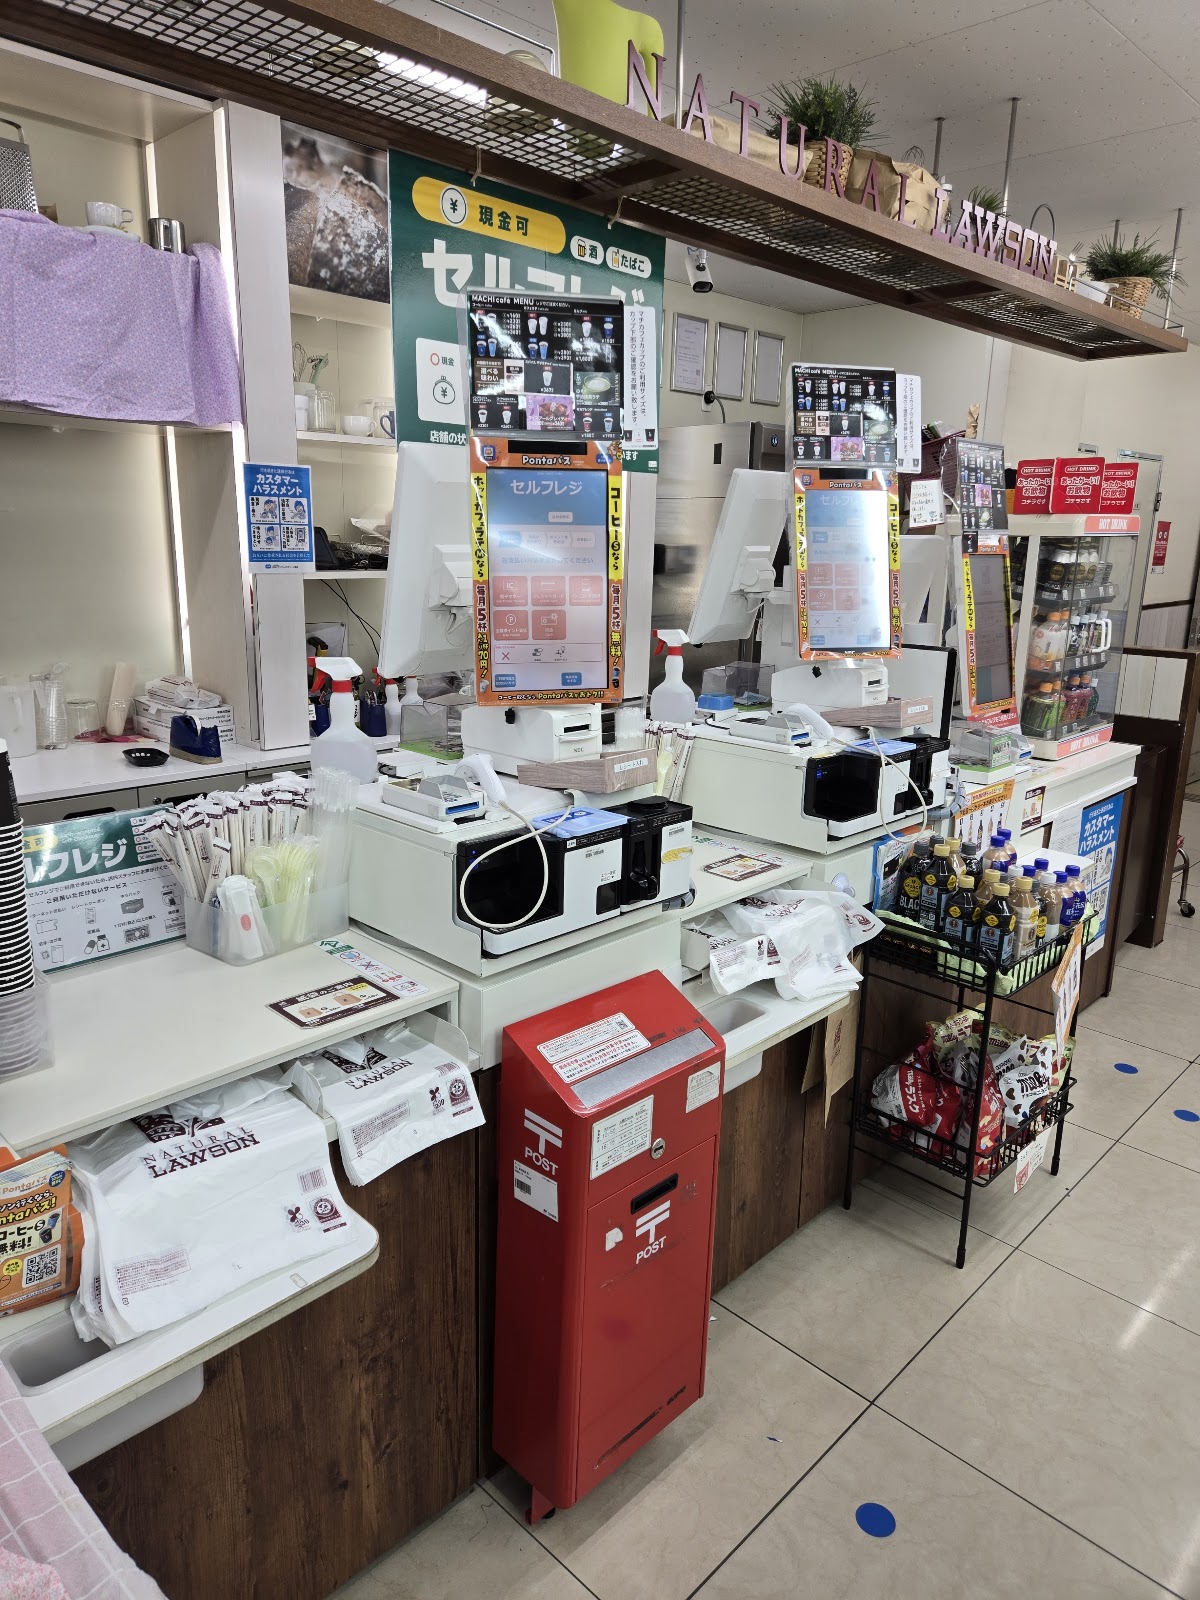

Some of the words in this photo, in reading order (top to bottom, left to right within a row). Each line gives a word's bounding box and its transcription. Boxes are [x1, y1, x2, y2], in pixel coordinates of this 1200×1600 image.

[624, 38, 918, 230] NATURAL
[931, 187, 1058, 284] LAWSON
[478, 204, 530, 237] 現金可
[588, 244, 598, 260] 酒
[620, 254, 646, 273] たばこ
[471, 295, 496, 304] MACHI
[513, 297, 535, 306] MENU
[441, 356, 455, 367] 現金
[430, 430, 467, 445] 店舗の状
[522, 455, 572, 466] Pontaパス
[256, 473, 299, 485] カスタマー
[510, 480, 583, 496] セルフレジ
[252, 484, 303, 496] ハラスメント
[1022, 487, 1047, 497] お飲物
[1066, 486, 1092, 496] お飲物
[1103, 488, 1127, 498] お飲物
[1099, 518, 1110, 530] HOT
[1110, 518, 1129, 530] DRINK
[476, 585, 488, 633] 毎月5杯
[611, 584, 622, 631] 毎月5杯
[1084, 814, 1115, 838] カスタマー
[1078, 825, 1115, 855] ハラスメント
[46, 882, 128, 904] ご利用いただけないサービス
[900, 896, 920, 910] BLAC
[345, 1057, 411, 1086] NATURAL
[350, 1060, 414, 1090] LAWSON
[143, 1126, 253, 1166] NATURAL
[148, 1133, 261, 1179] LAWSON
[525, 1146, 559, 1176] POST
[2, 1174, 48, 1194] Pontaパス
[636, 1235, 667, 1264] POST
